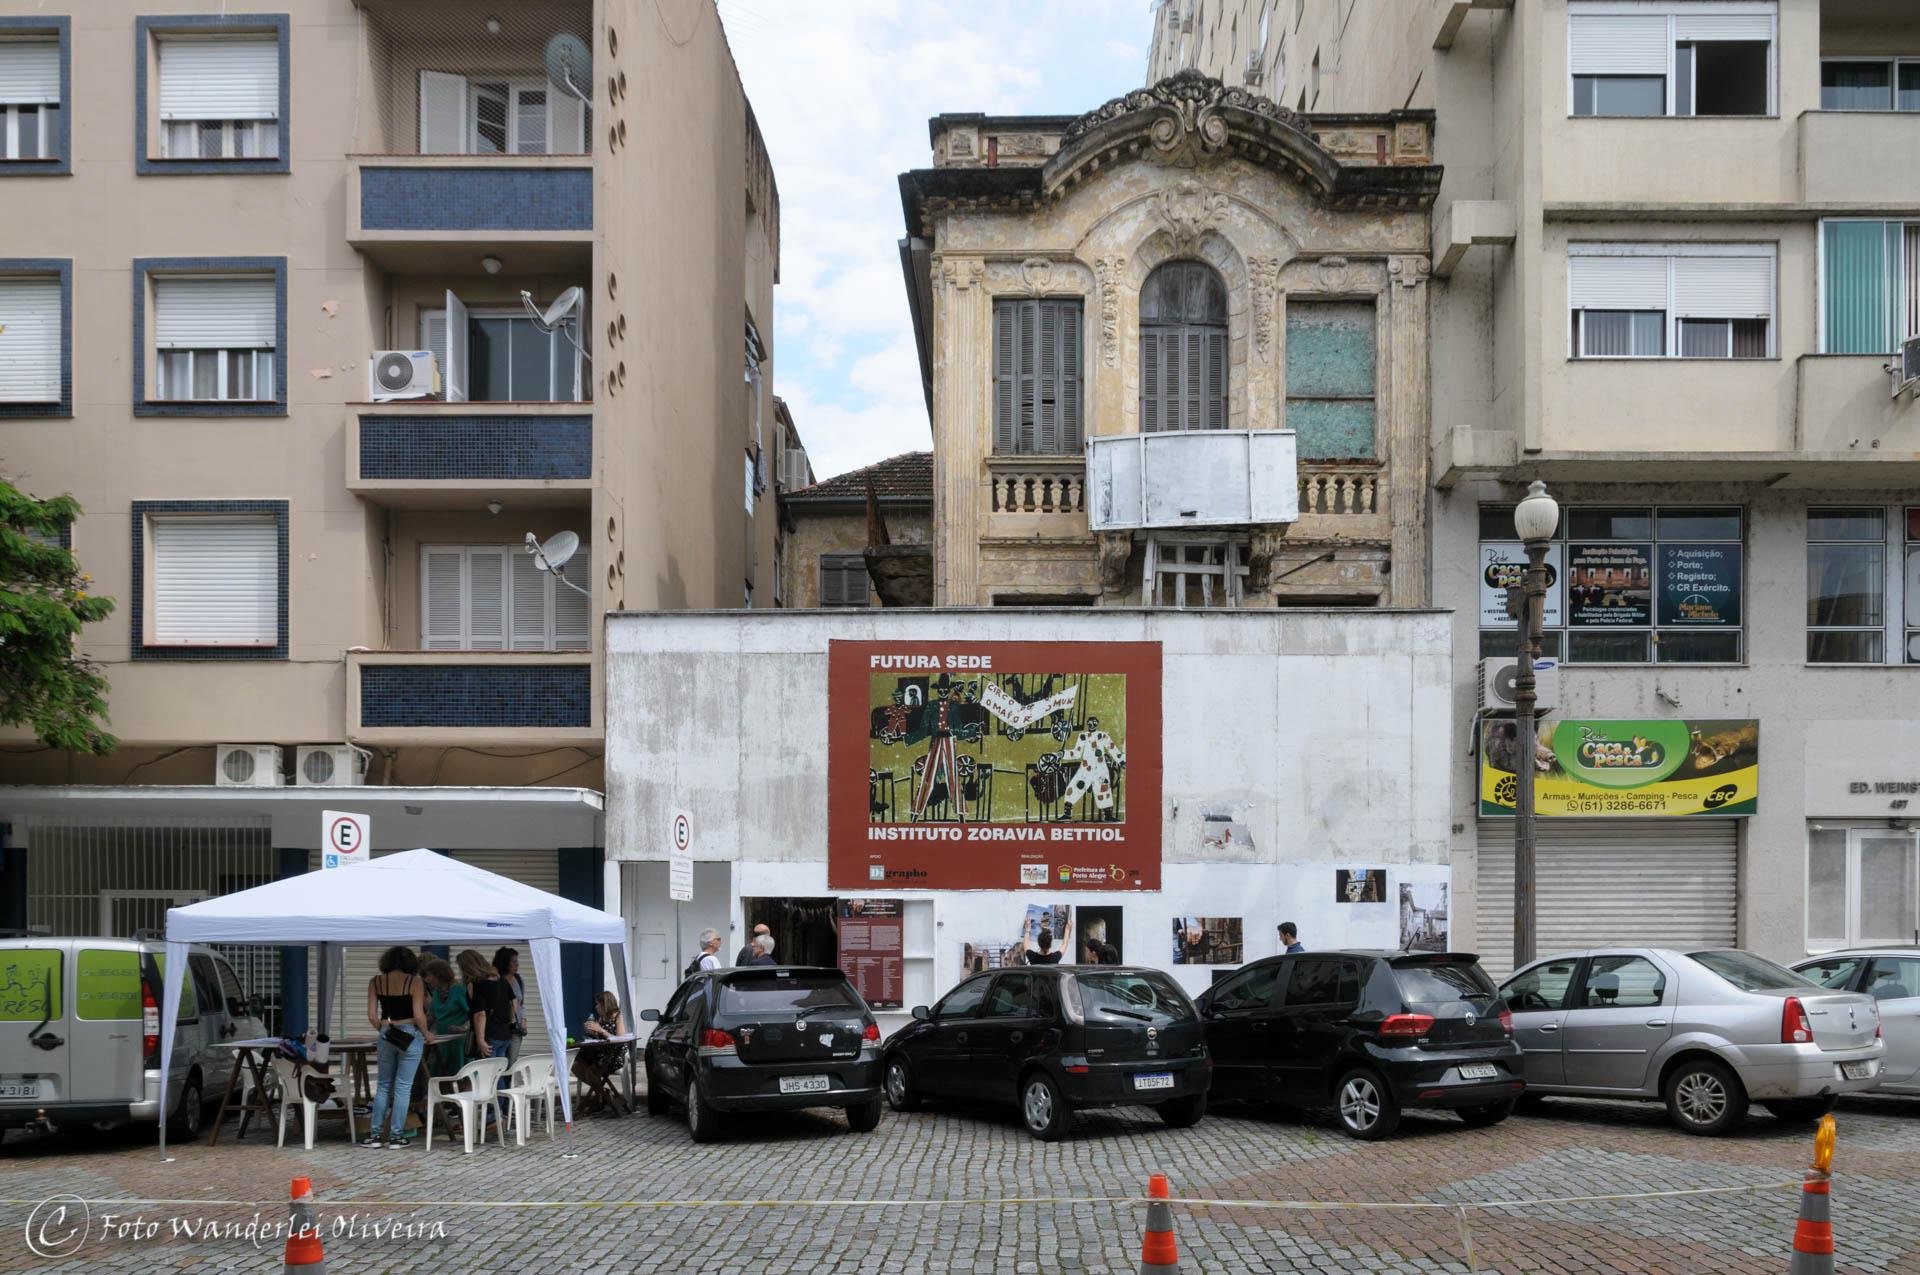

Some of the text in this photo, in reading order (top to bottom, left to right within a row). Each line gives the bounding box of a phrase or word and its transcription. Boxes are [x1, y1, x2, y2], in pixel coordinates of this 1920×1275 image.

[1677, 561, 1703, 569] Porte;
[1677, 572, 1717, 581] Registro;
[1677, 583, 1731, 592] CR Exército.
[871, 655, 992, 669] FUTURA SEDE
[1594, 754, 1643, 768] Pesca
[1849, 782, 1920, 793] ED. WEINS
[1543, 792, 1571, 800] Armas
[1578, 791, 1619, 802] Munições
[1626, 791, 1664, 802] Camping
[1672, 791, 1698, 800] Pesca
[1707, 791, 1736, 801] CBC
[1580, 800, 1667, 812] (51) 3286-6671
[341, 825, 352, 846] E
[679, 822, 685, 843] E
[868, 828, 1125, 842] INSTITUTO ZORAVIA BETTIOL
[783, 1079, 827, 1092] JHS-4330
